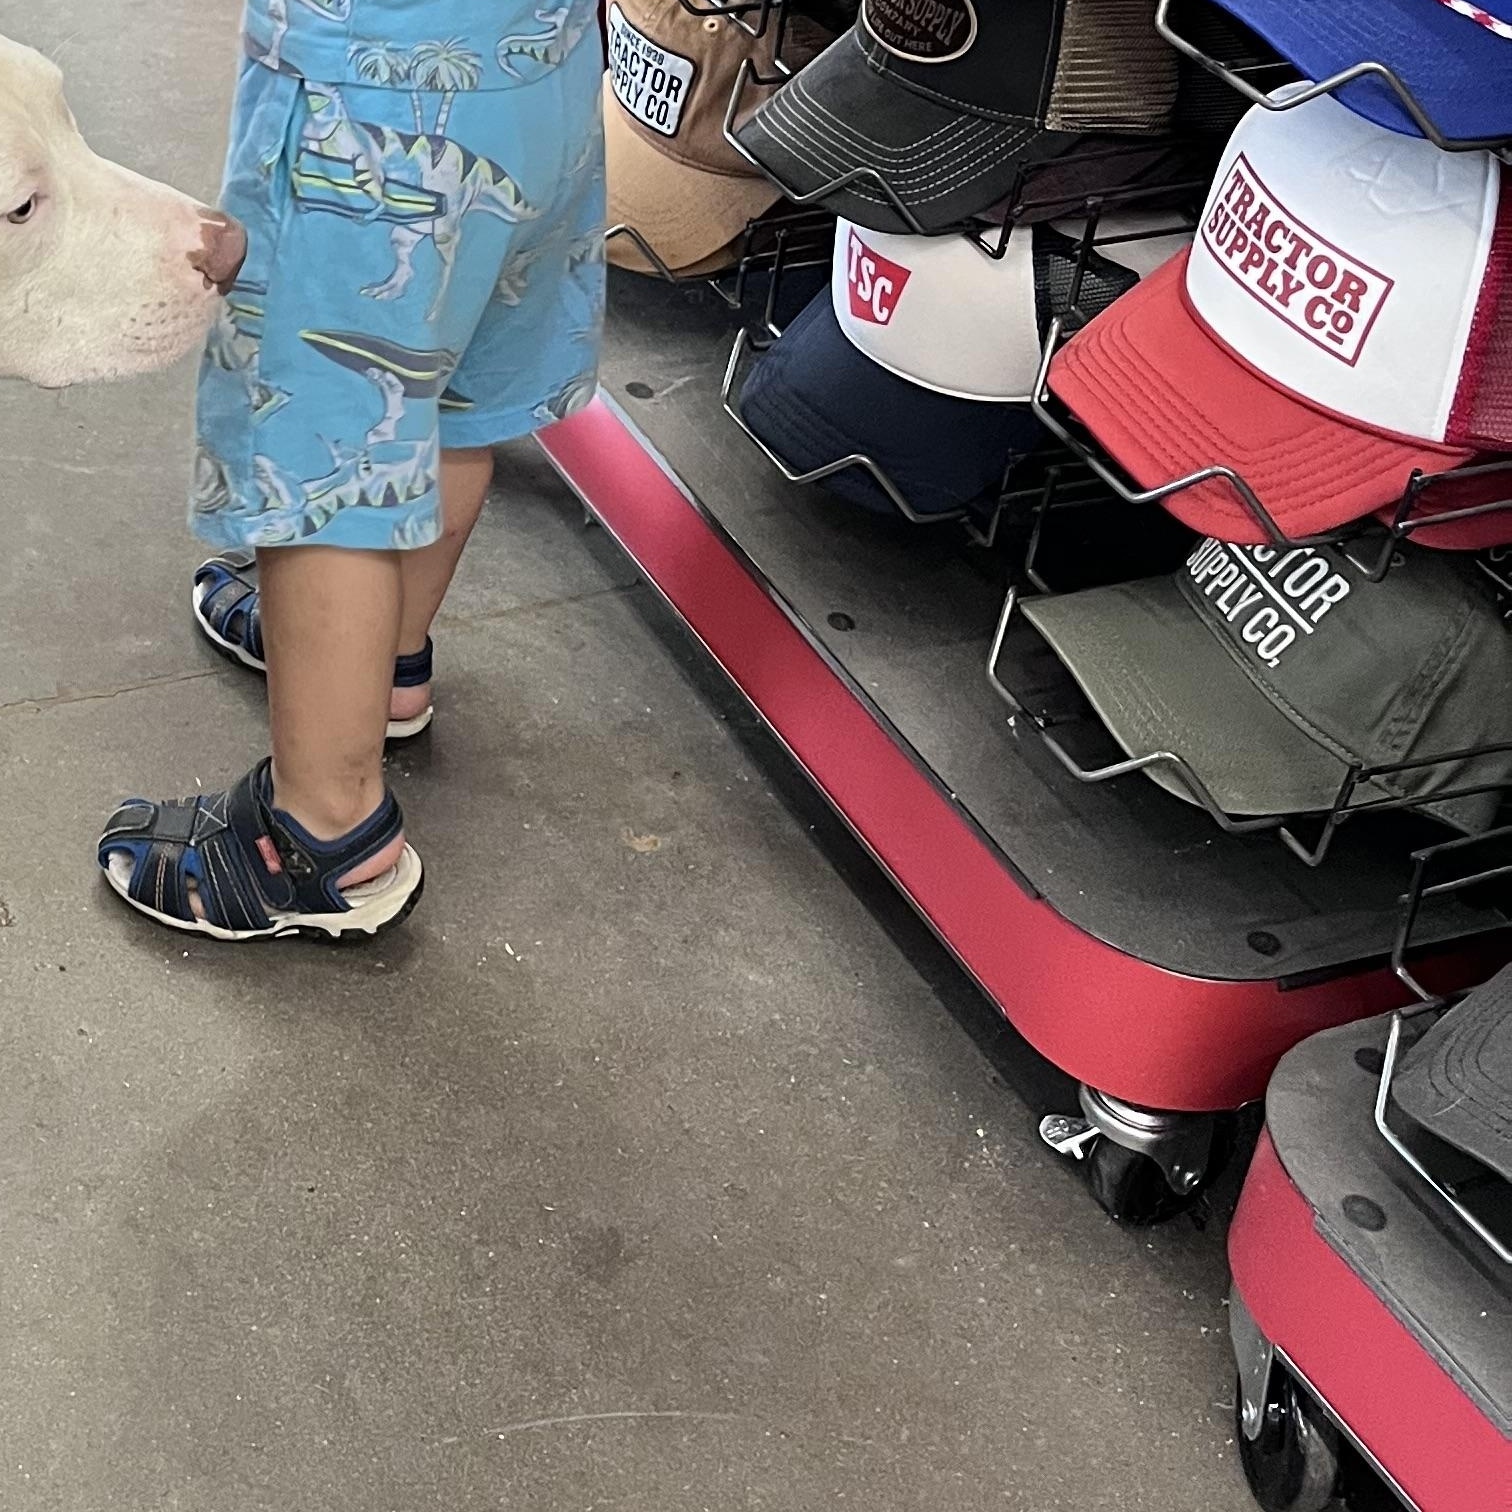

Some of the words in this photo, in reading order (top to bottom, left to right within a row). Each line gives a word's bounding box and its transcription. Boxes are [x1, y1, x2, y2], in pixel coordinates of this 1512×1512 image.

[644, 94, 671, 130] CO.
[849, 234, 893, 322] TSC
[1208, 202, 1306, 308] SUPPLY
[1224, 168, 1369, 314] TRACTOR
